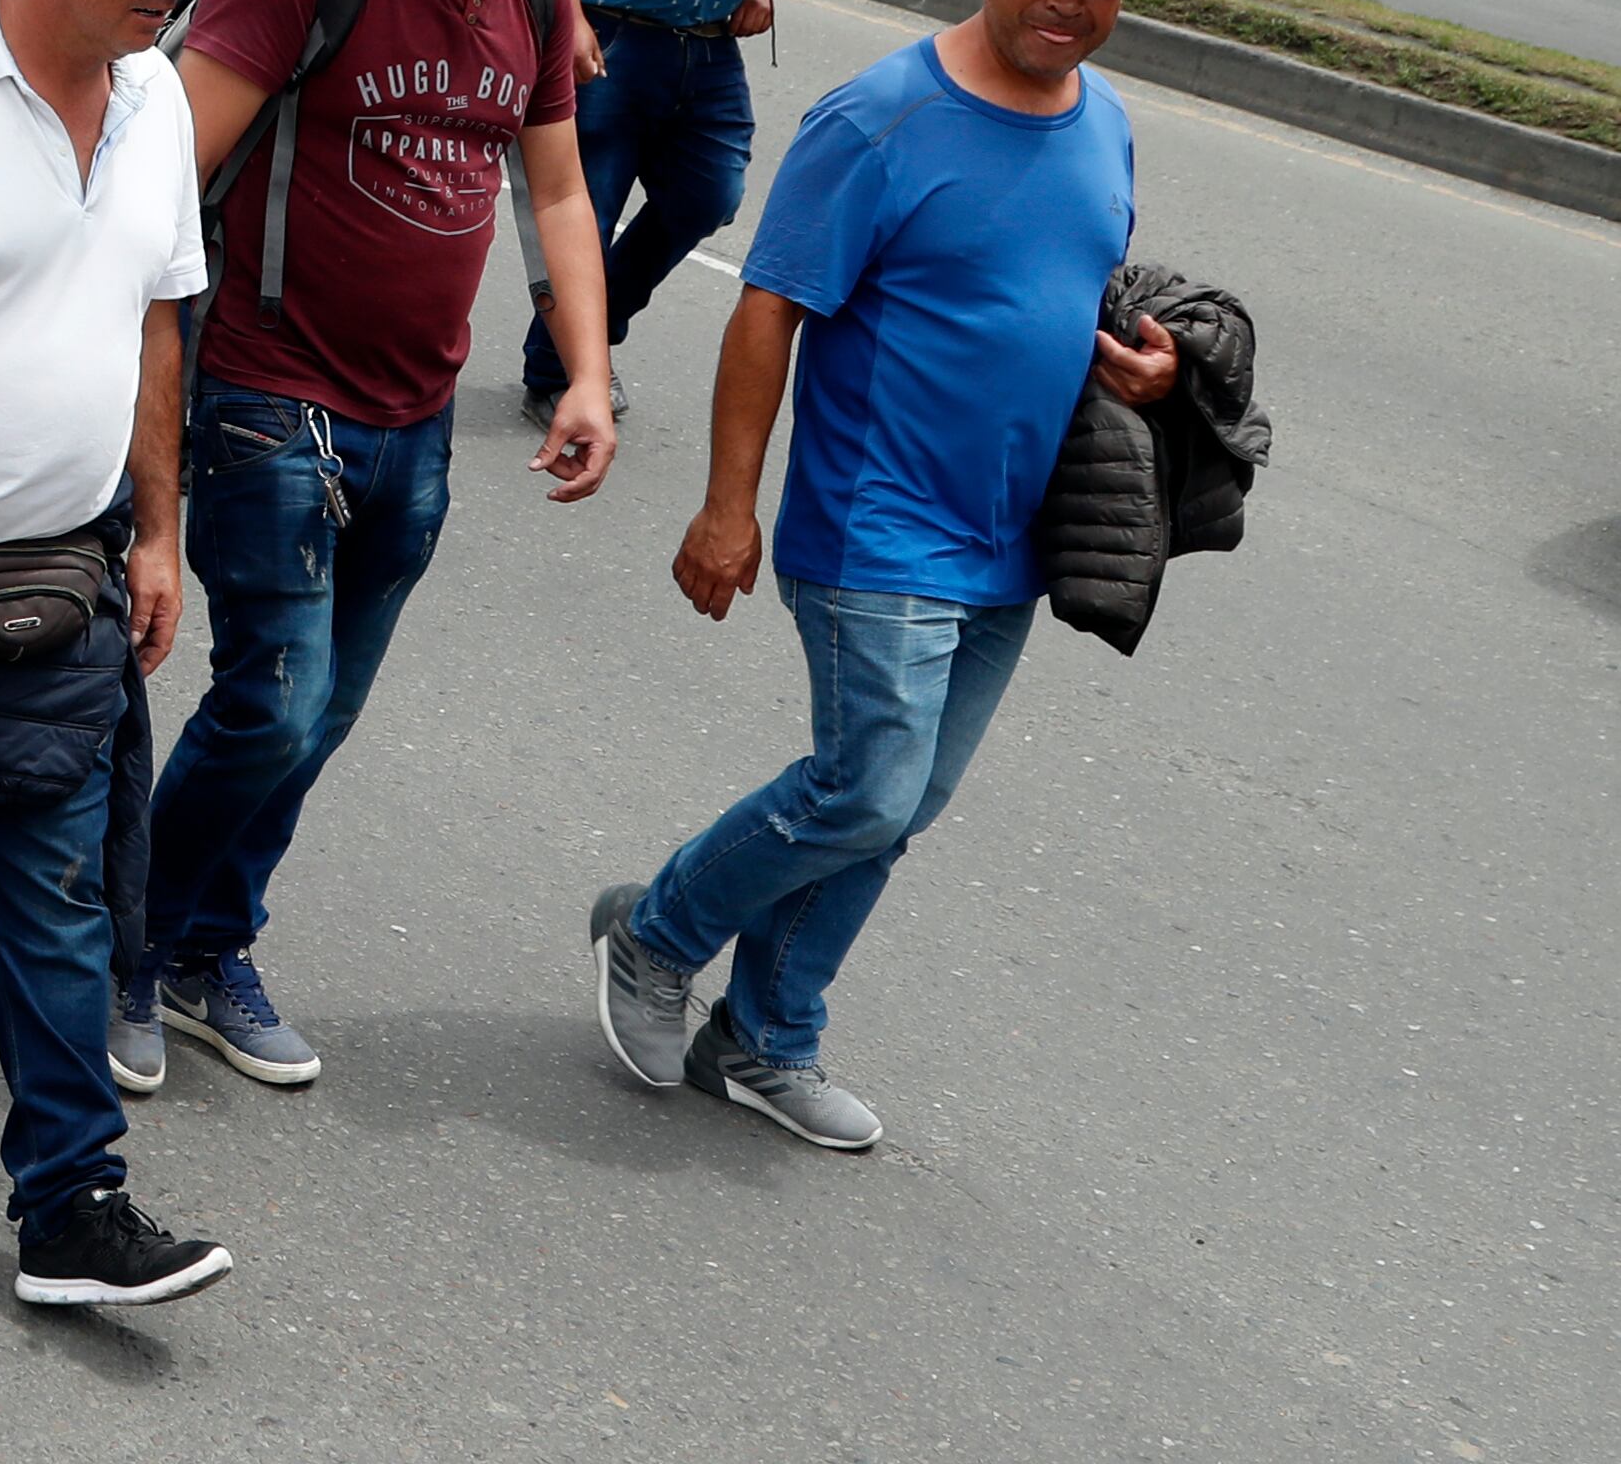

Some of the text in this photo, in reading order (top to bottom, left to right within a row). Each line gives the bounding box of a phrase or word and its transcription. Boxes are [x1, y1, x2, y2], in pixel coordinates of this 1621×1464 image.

[355, 59, 527, 117] HUGO BOS
[445, 95, 470, 107] THE
[403, 113, 500, 135] SUPERIOR
[361, 129, 468, 163] APPAREL
[407, 166, 486, 185] QUALITY
[445, 185, 454, 199] &
